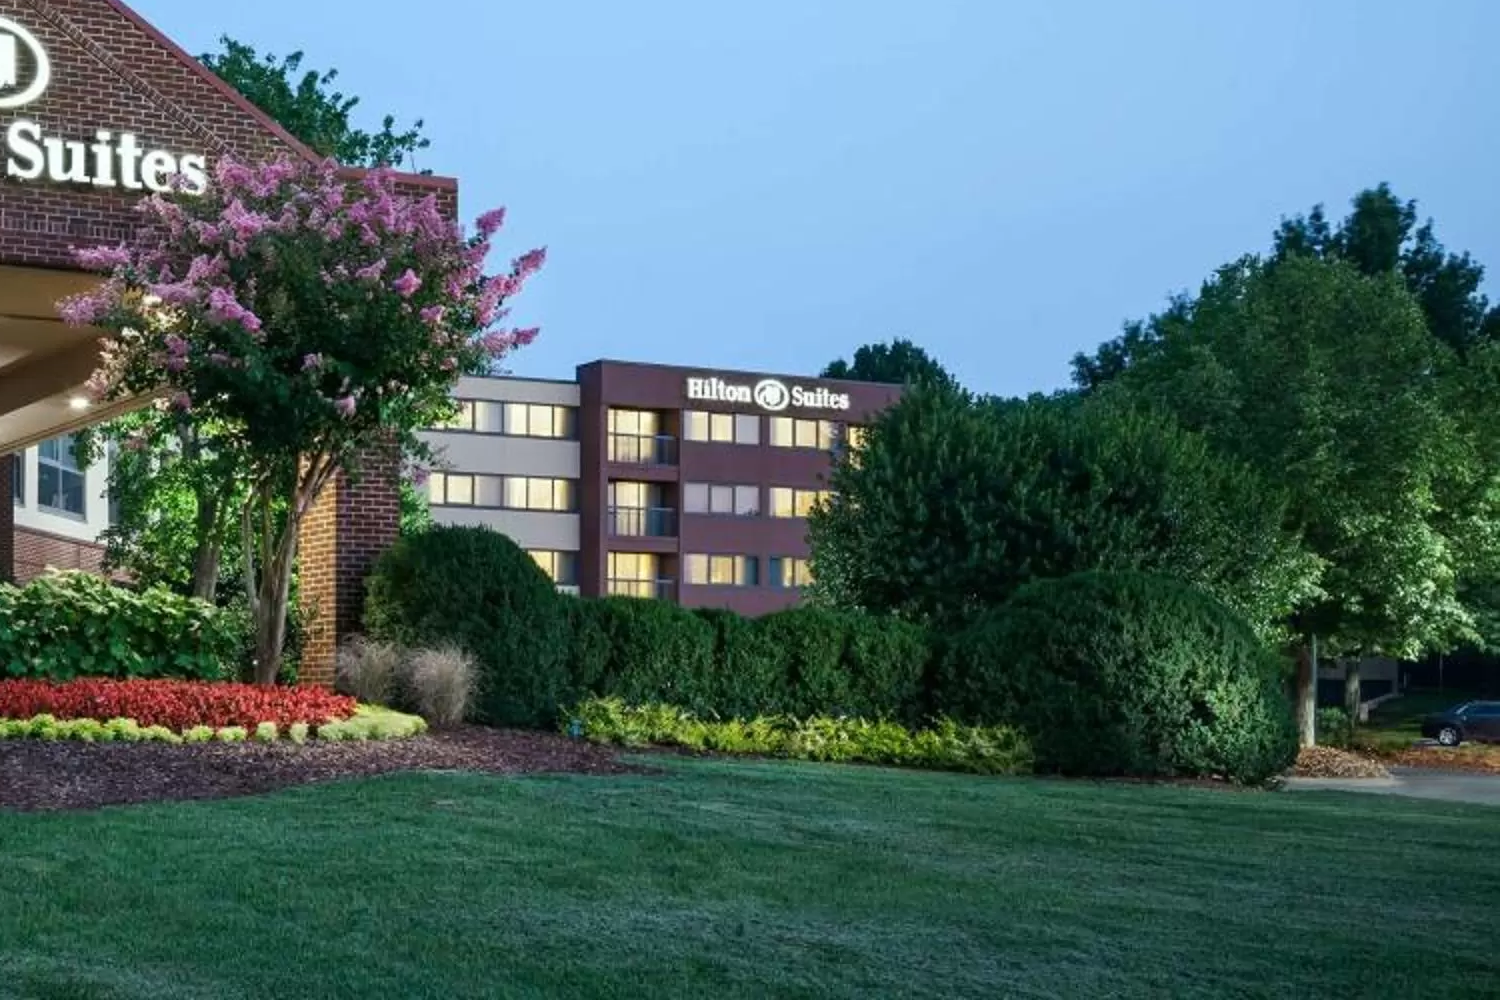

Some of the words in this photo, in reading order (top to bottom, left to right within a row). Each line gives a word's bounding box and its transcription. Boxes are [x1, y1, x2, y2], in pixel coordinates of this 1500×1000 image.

[5, 120, 208, 197] Suites
[687, 377, 752, 403] Hilton
[792, 386, 850, 410] Suites
